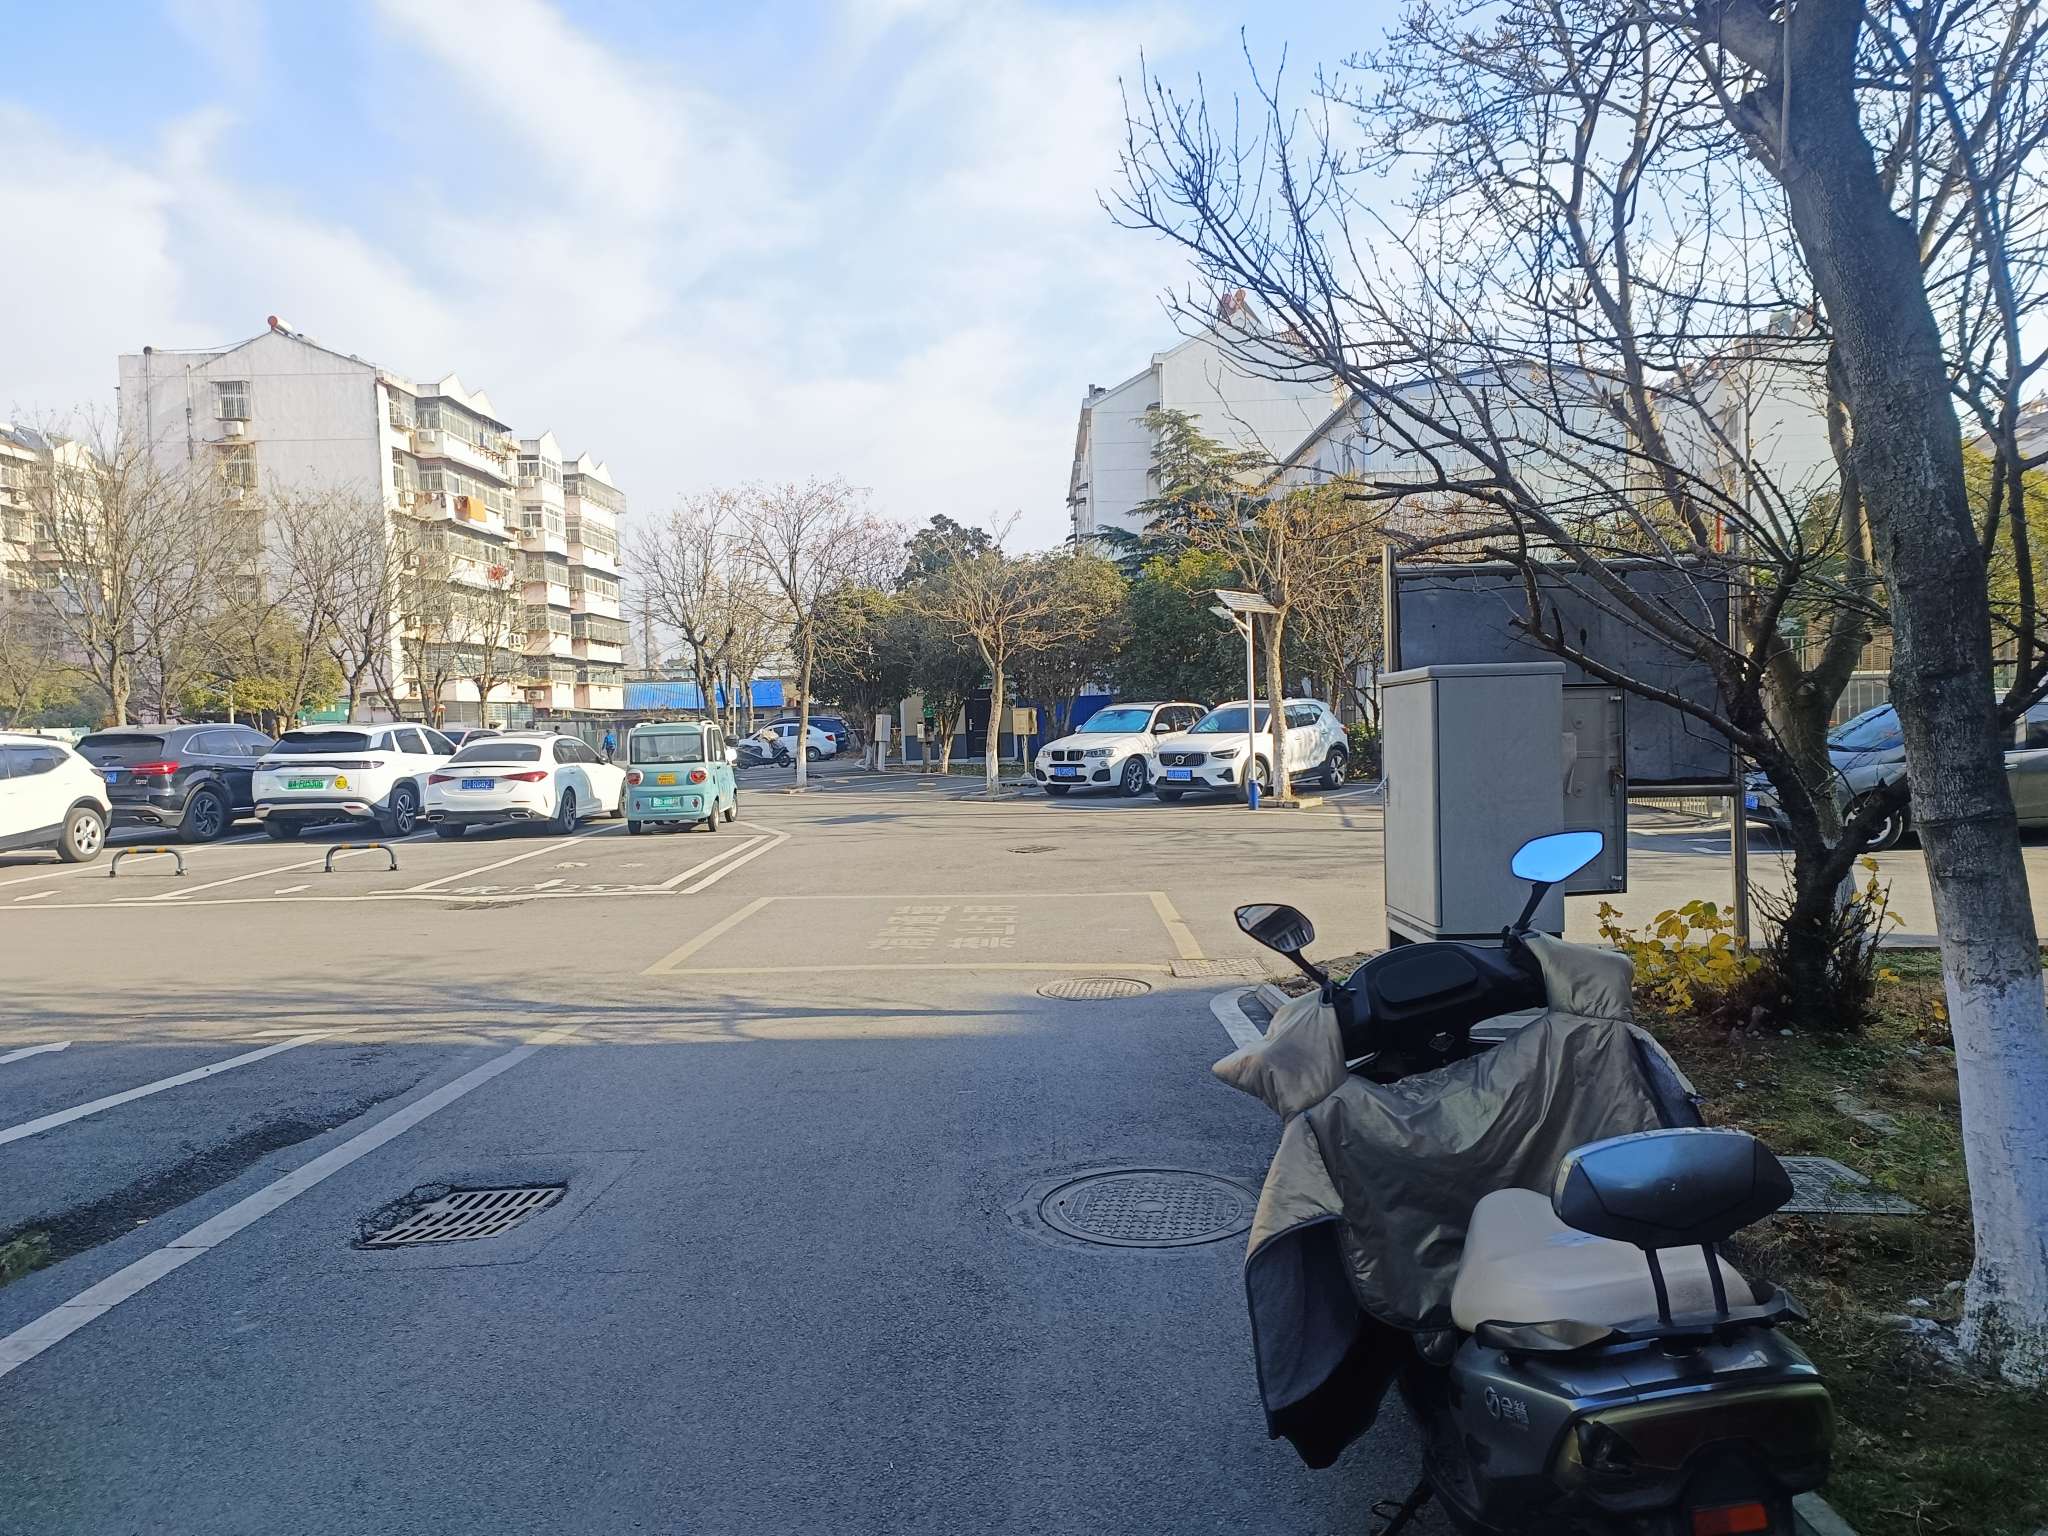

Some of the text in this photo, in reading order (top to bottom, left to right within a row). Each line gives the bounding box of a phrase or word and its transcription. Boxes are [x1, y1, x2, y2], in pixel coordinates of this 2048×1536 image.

[864, 904, 959, 950] 消防通道
[948, 904, 1018, 949] 禁止占用
